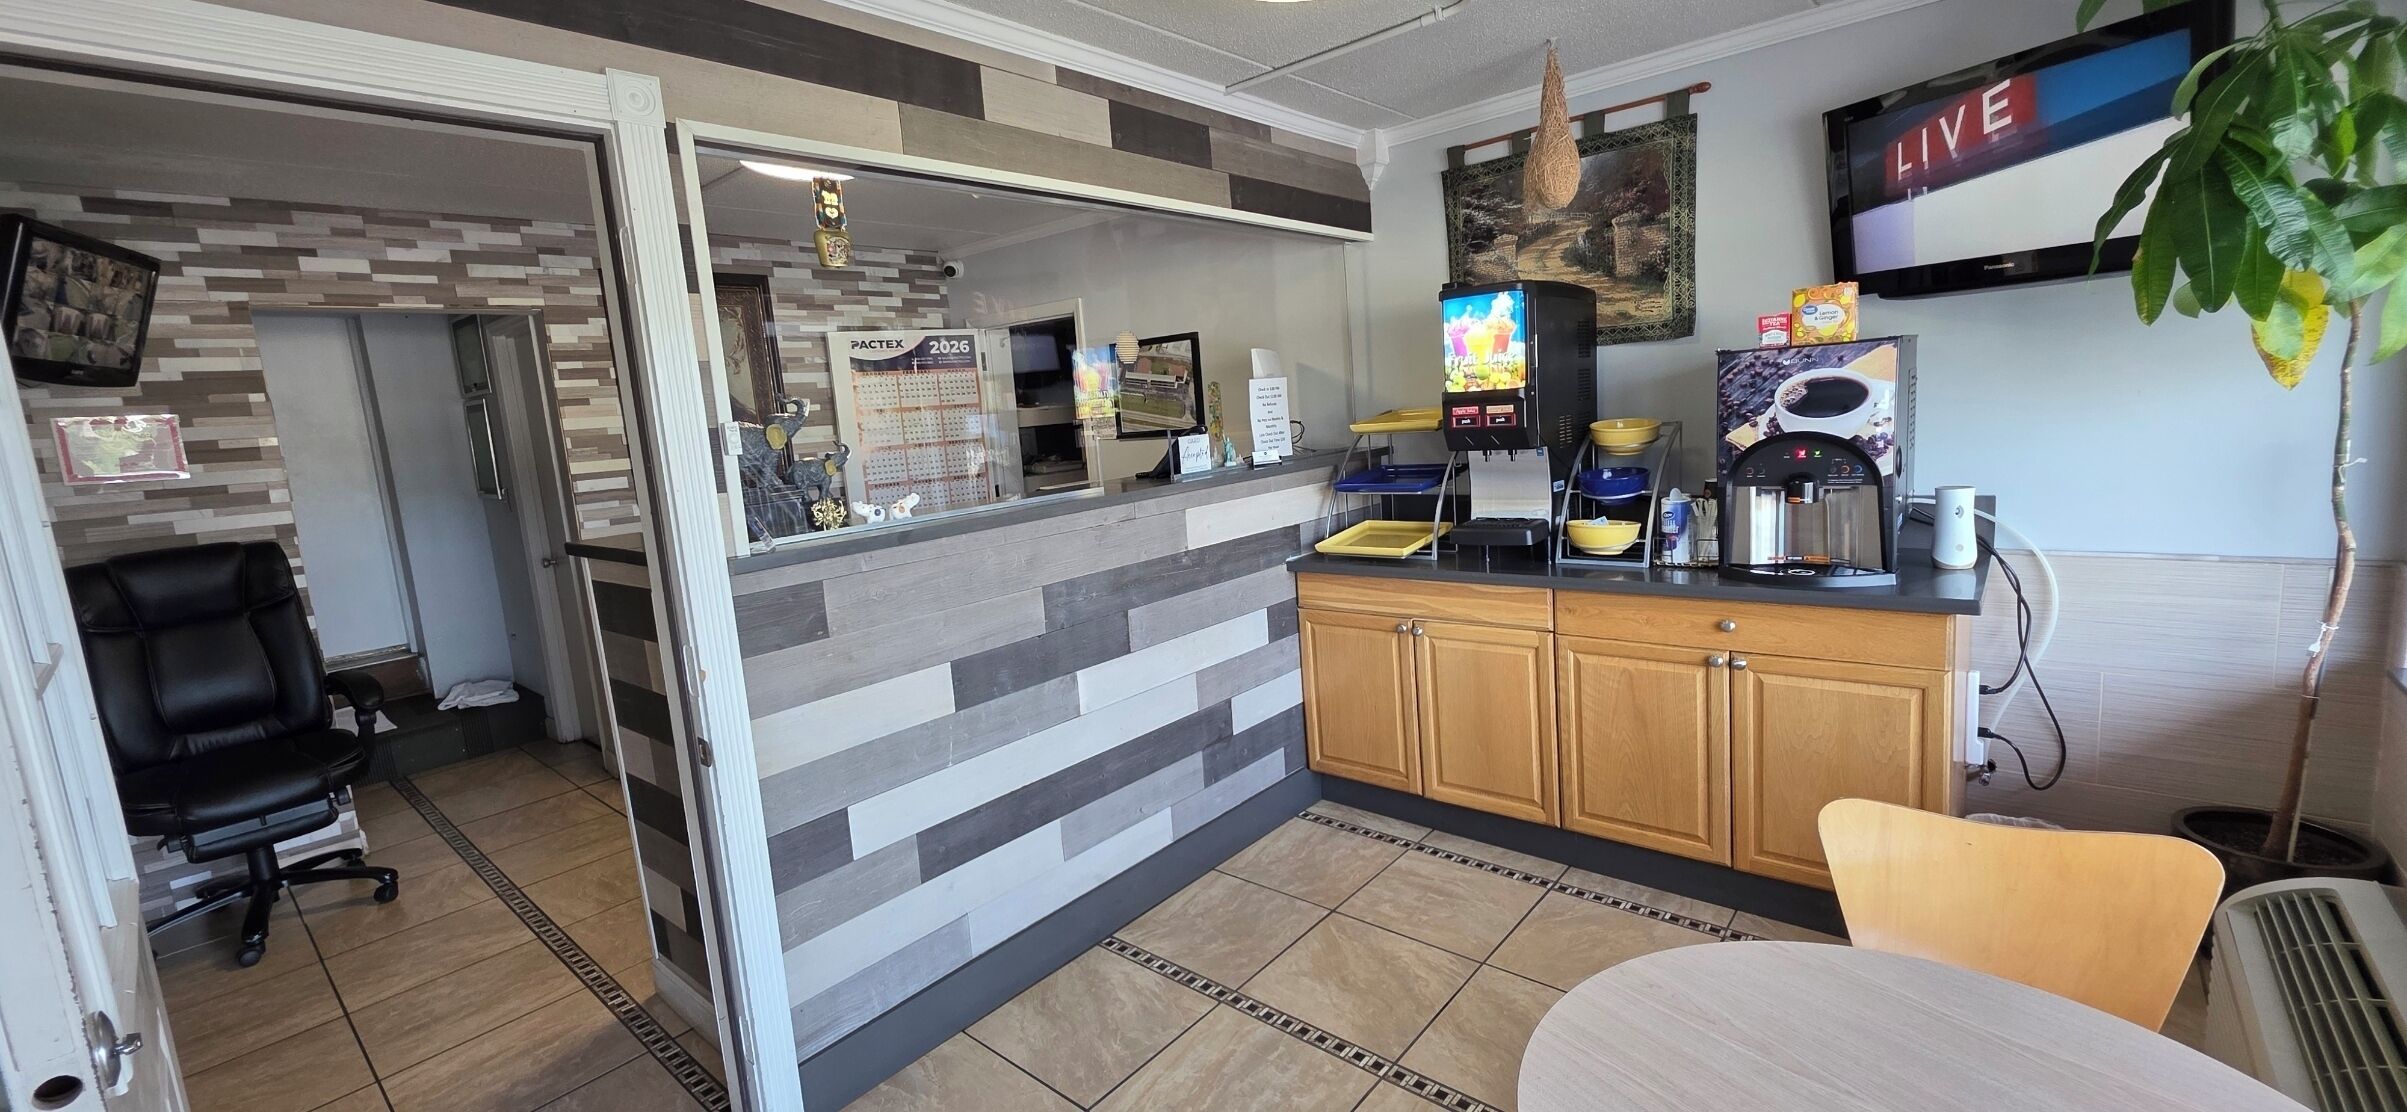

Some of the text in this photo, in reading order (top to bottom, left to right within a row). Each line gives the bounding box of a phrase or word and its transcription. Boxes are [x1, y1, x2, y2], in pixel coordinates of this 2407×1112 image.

[1897, 78, 2012, 181] LIVE
[850, 339, 905, 350] PACTEX
[928, 340, 970, 354] 2026
